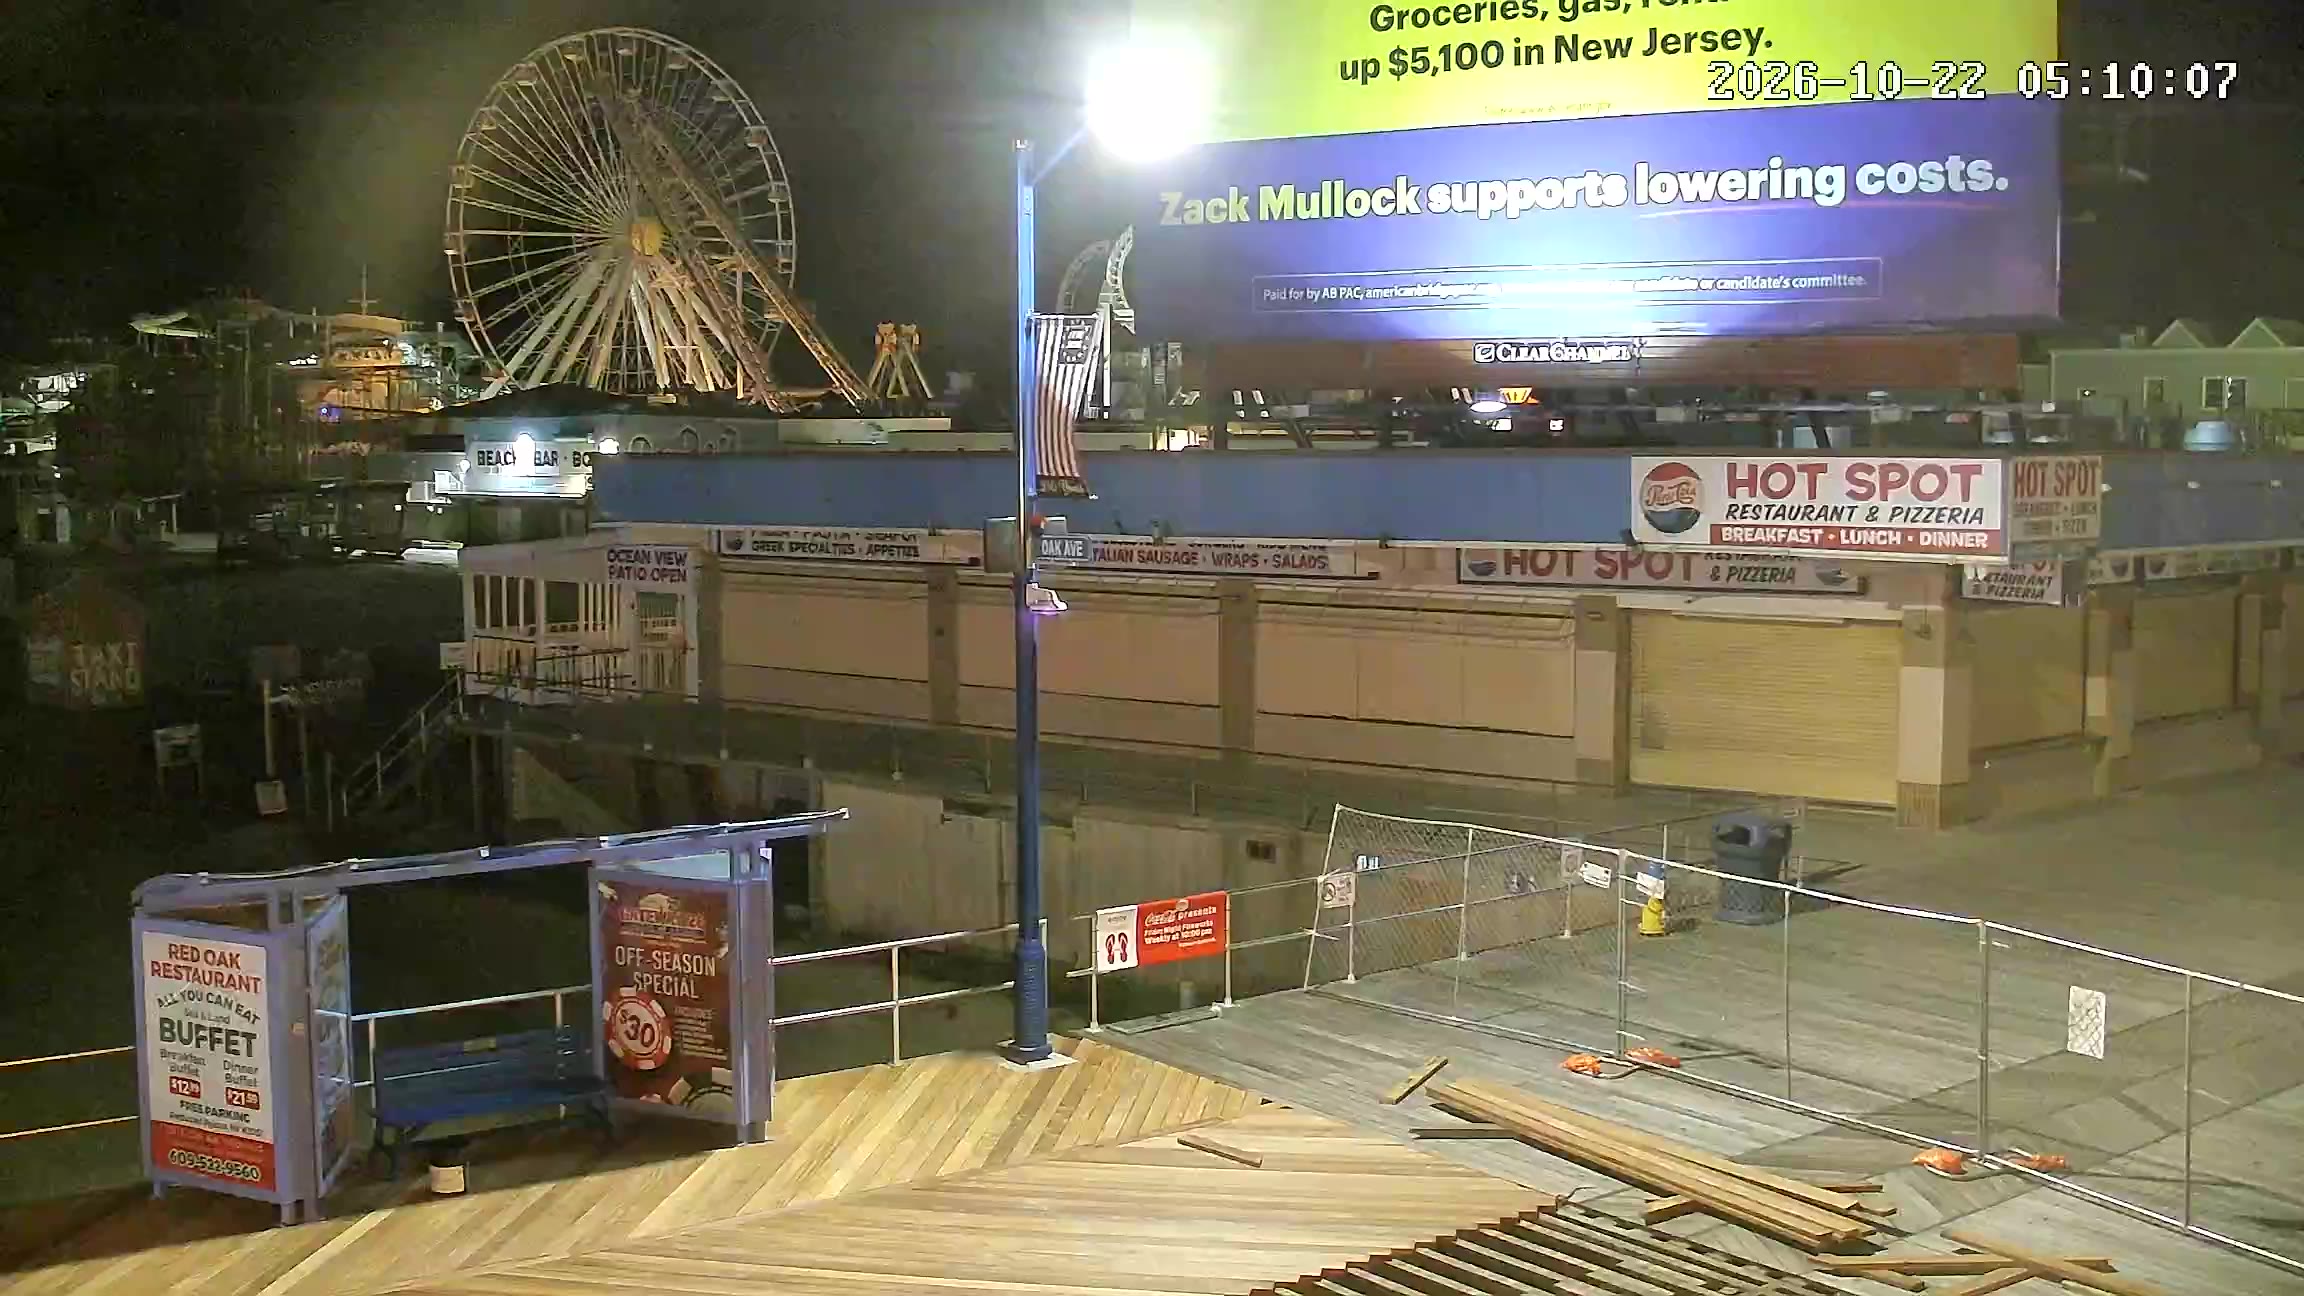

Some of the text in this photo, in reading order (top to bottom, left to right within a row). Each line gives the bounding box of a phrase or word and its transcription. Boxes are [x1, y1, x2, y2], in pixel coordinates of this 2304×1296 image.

[1370, 0, 1549, 32] Groceries,
[1340, 24, 1773, 84] up $5,100 in New Jersey.
[1159, 153, 2009, 226] Zack Mullock supports lowering costs.
[1263, 288, 1287, 301] Paid
[1289, 287, 1304, 300] for
[1306, 286, 1320, 302] by
[534, 450, 558, 466] BAR
[1727, 462, 1983, 502] HOT SPOT
[2014, 459, 2100, 498] HOT SPOT
[1725, 503, 1985, 525] RESTAURANT & PIZZERIA
[1042, 540, 1061, 556] OAK
[1063, 540, 1083, 556] AVE
[1721, 526, 1988, 548] BREAKFAST LUNCH DINNER
[608, 550, 688, 566] OCEAN VIEW
[1137, 550, 1198, 566] SAUSAGE
[1212, 552, 1259, 568] WRAPS
[1272, 554, 1328, 570] SALADS
[1503, 550, 1692, 581] HOT SPOT
[608, 567, 687, 582] PATIO OPEN
[1726, 565, 1796, 584] PIZZERIA
[168, 943, 242, 971] RED OAK
[615, 945, 716, 978] OFF-SEASON
[151, 960, 264, 995] RESTAURANT
[633, 971, 700, 1000] SPECIAL
[179, 990, 203, 1002] YOU
[206, 992, 234, 1010] CAN
[234, 1003, 261, 1025] EAT
[159, 1017, 257, 1058] BUFFET
[619, 1008, 658, 1048] $30
